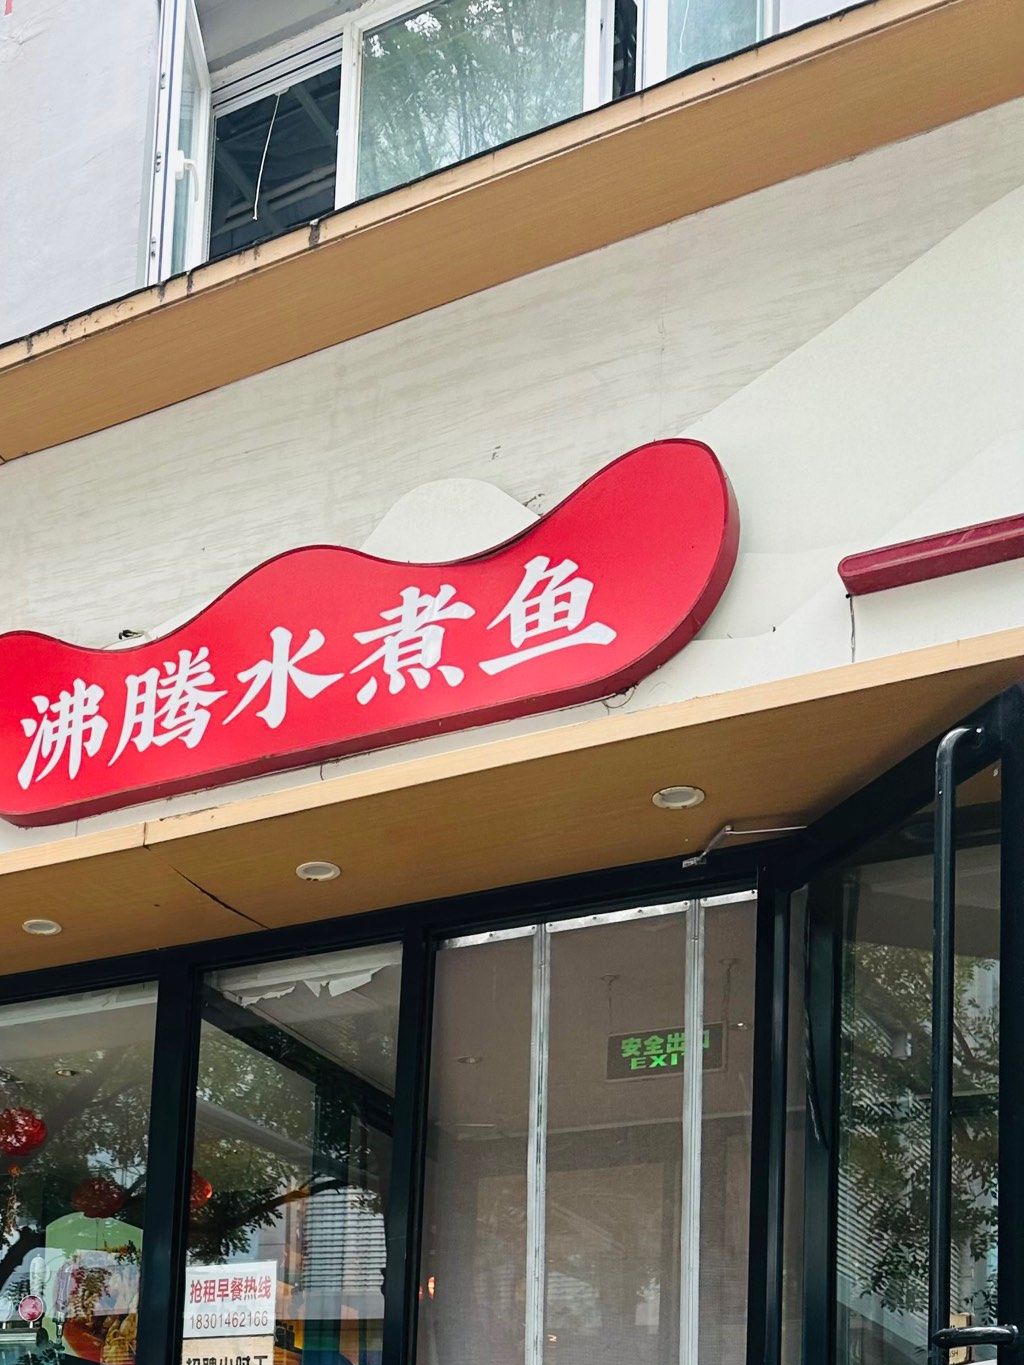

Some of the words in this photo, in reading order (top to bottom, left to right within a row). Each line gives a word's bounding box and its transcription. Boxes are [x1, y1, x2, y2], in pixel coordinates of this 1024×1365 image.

[17, 555, 616, 790] 沸腾水煮鱼
[620, 1029, 710, 1057] 安全出
[630, 1053, 684, 1070] EXI
[190, 1276, 271, 1303] 抢租早餐热线
[190, 1310, 268, 1329] 18301462166
